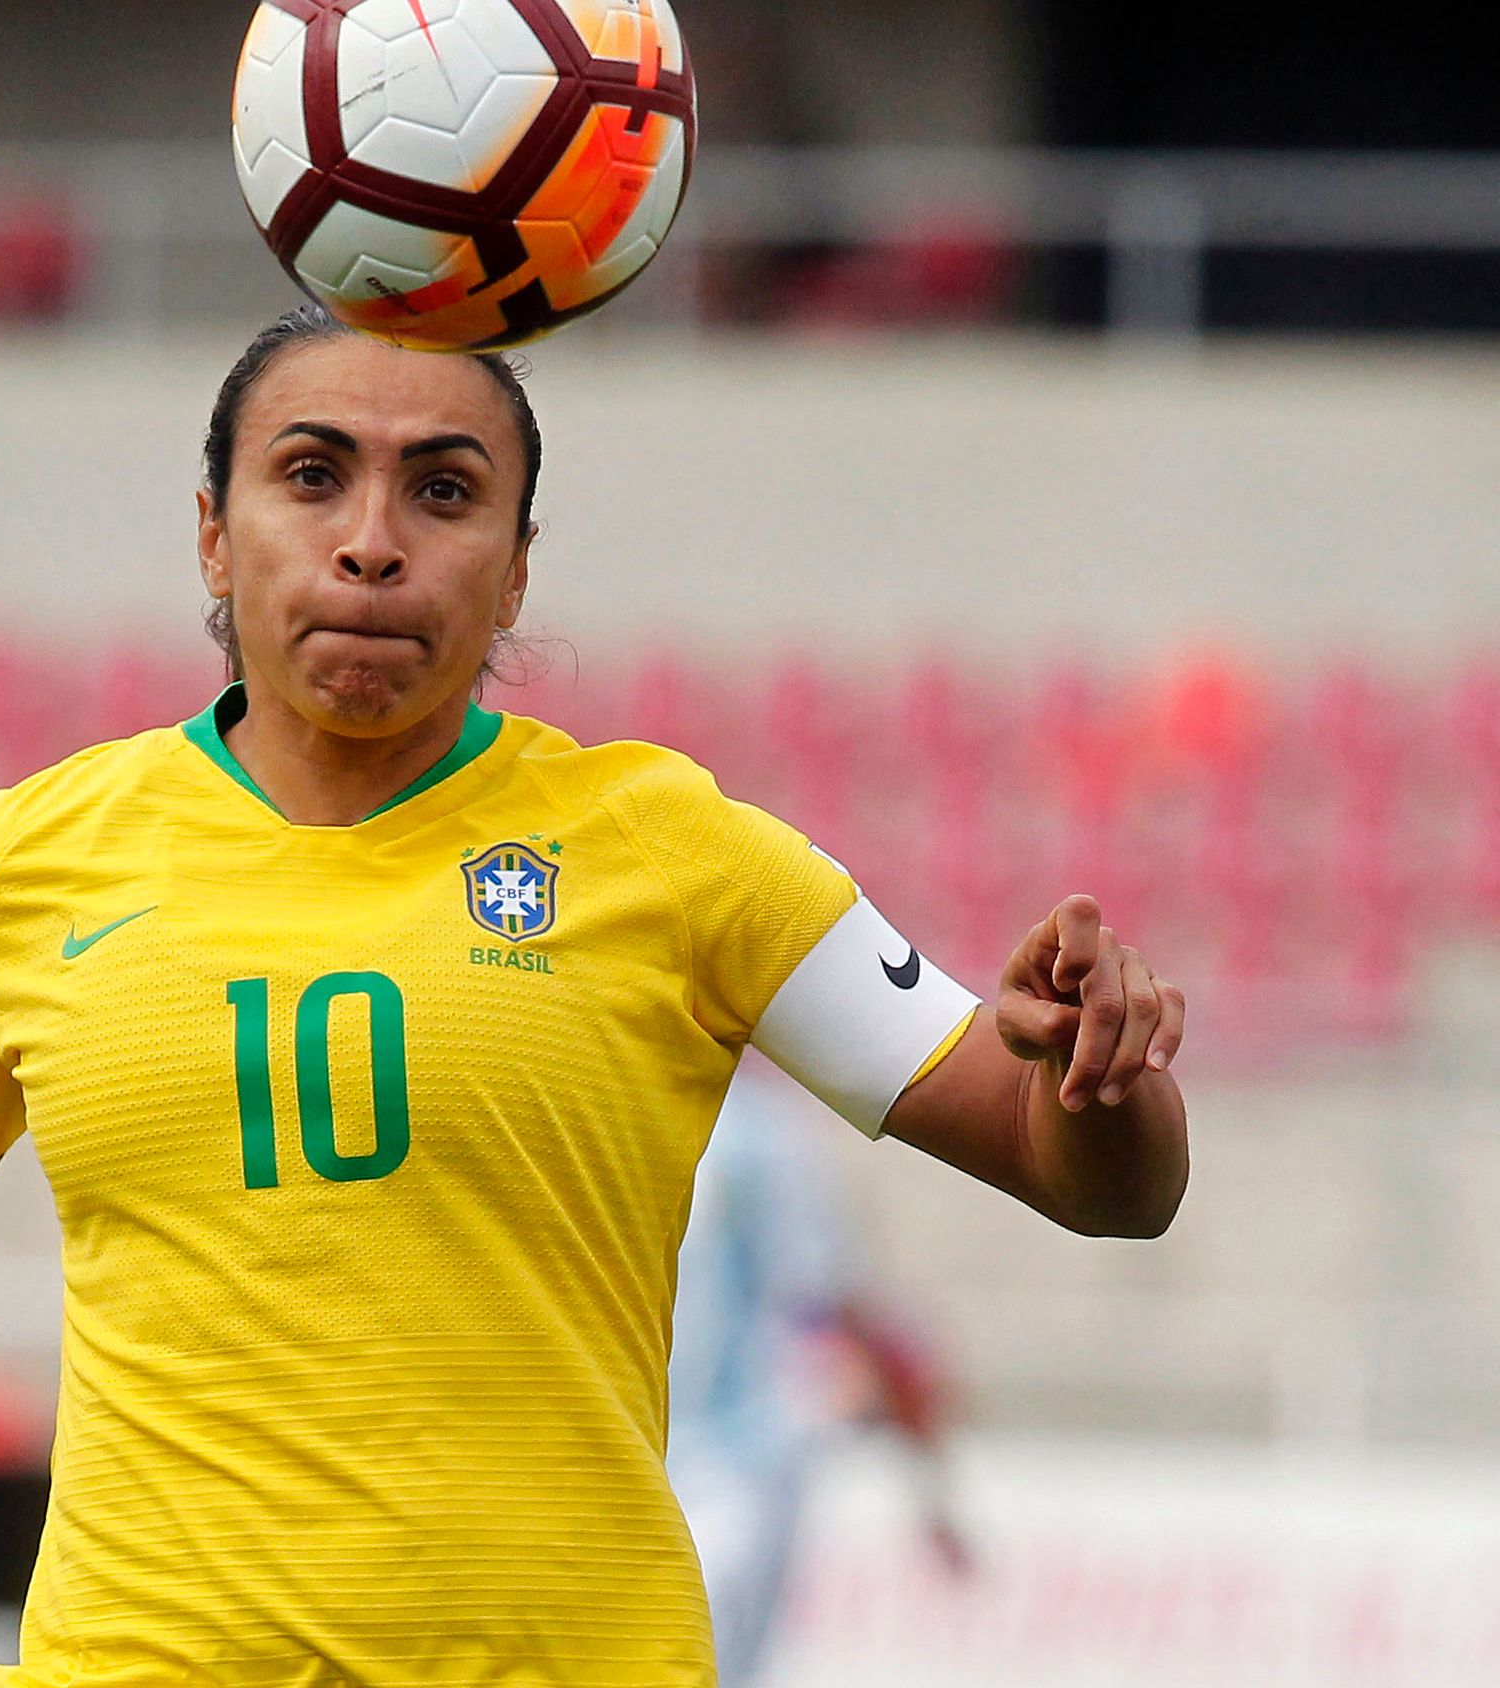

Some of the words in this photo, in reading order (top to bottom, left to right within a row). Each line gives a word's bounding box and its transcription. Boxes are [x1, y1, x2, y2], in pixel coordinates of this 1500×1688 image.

[496, 887, 526, 899] CBF
[470, 947, 554, 974] BRASIL
[227, 971, 411, 1190] 10
